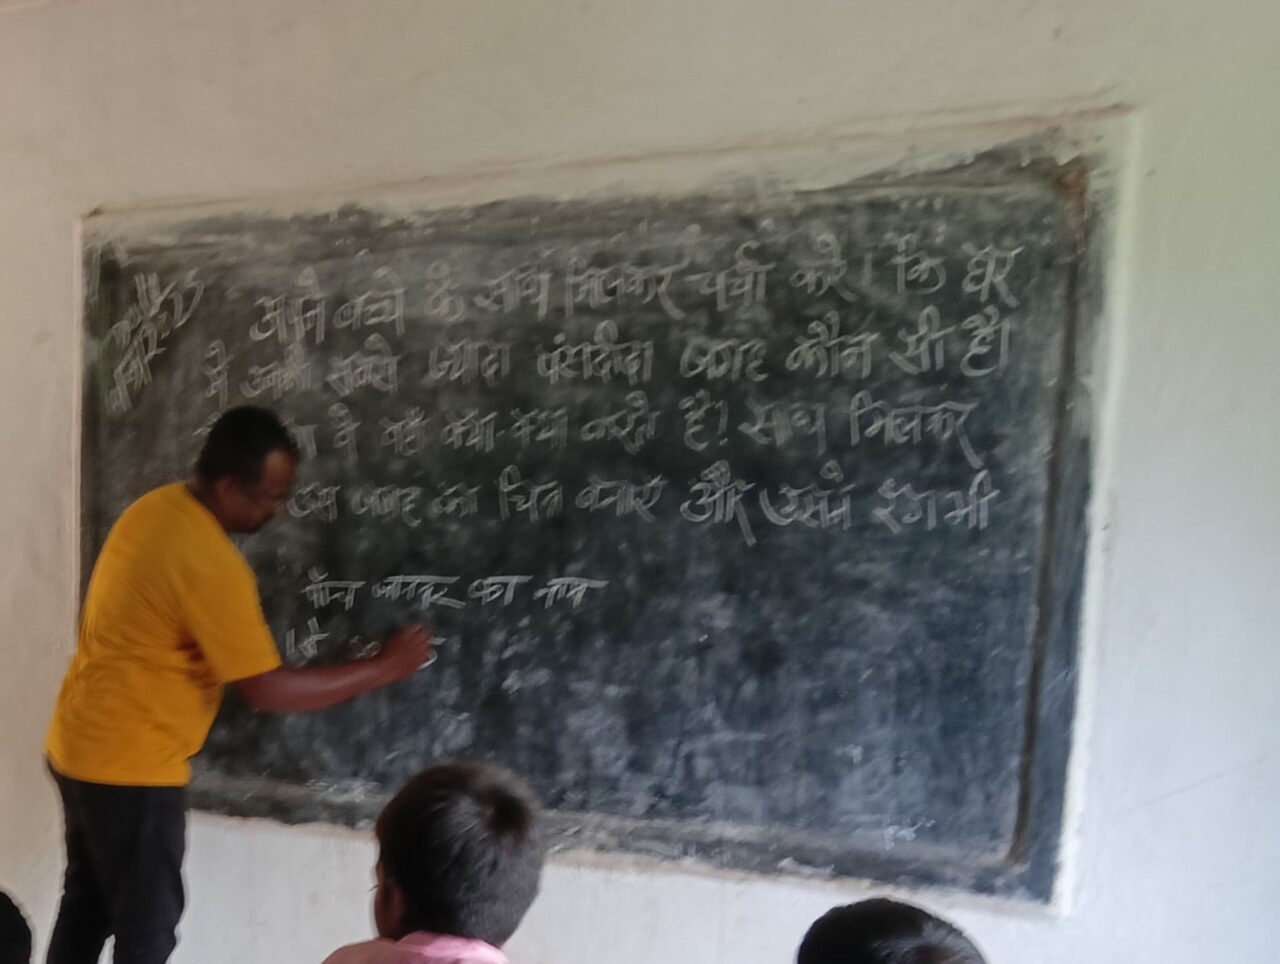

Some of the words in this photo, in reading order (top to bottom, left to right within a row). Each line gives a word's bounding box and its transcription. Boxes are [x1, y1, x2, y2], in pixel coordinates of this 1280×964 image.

[425, 260, 464, 322] के
[962, 243, 1025, 308] घर
[785, 311, 881, 379] कौन
[849, 390, 984, 468] मिलकर
[430, 481, 482, 518] का
[680, 459, 757, 547] और
[944, 469, 1000, 531] भी
[468, 574, 533, 606] का
[533, 577, 610, 610] नाम
